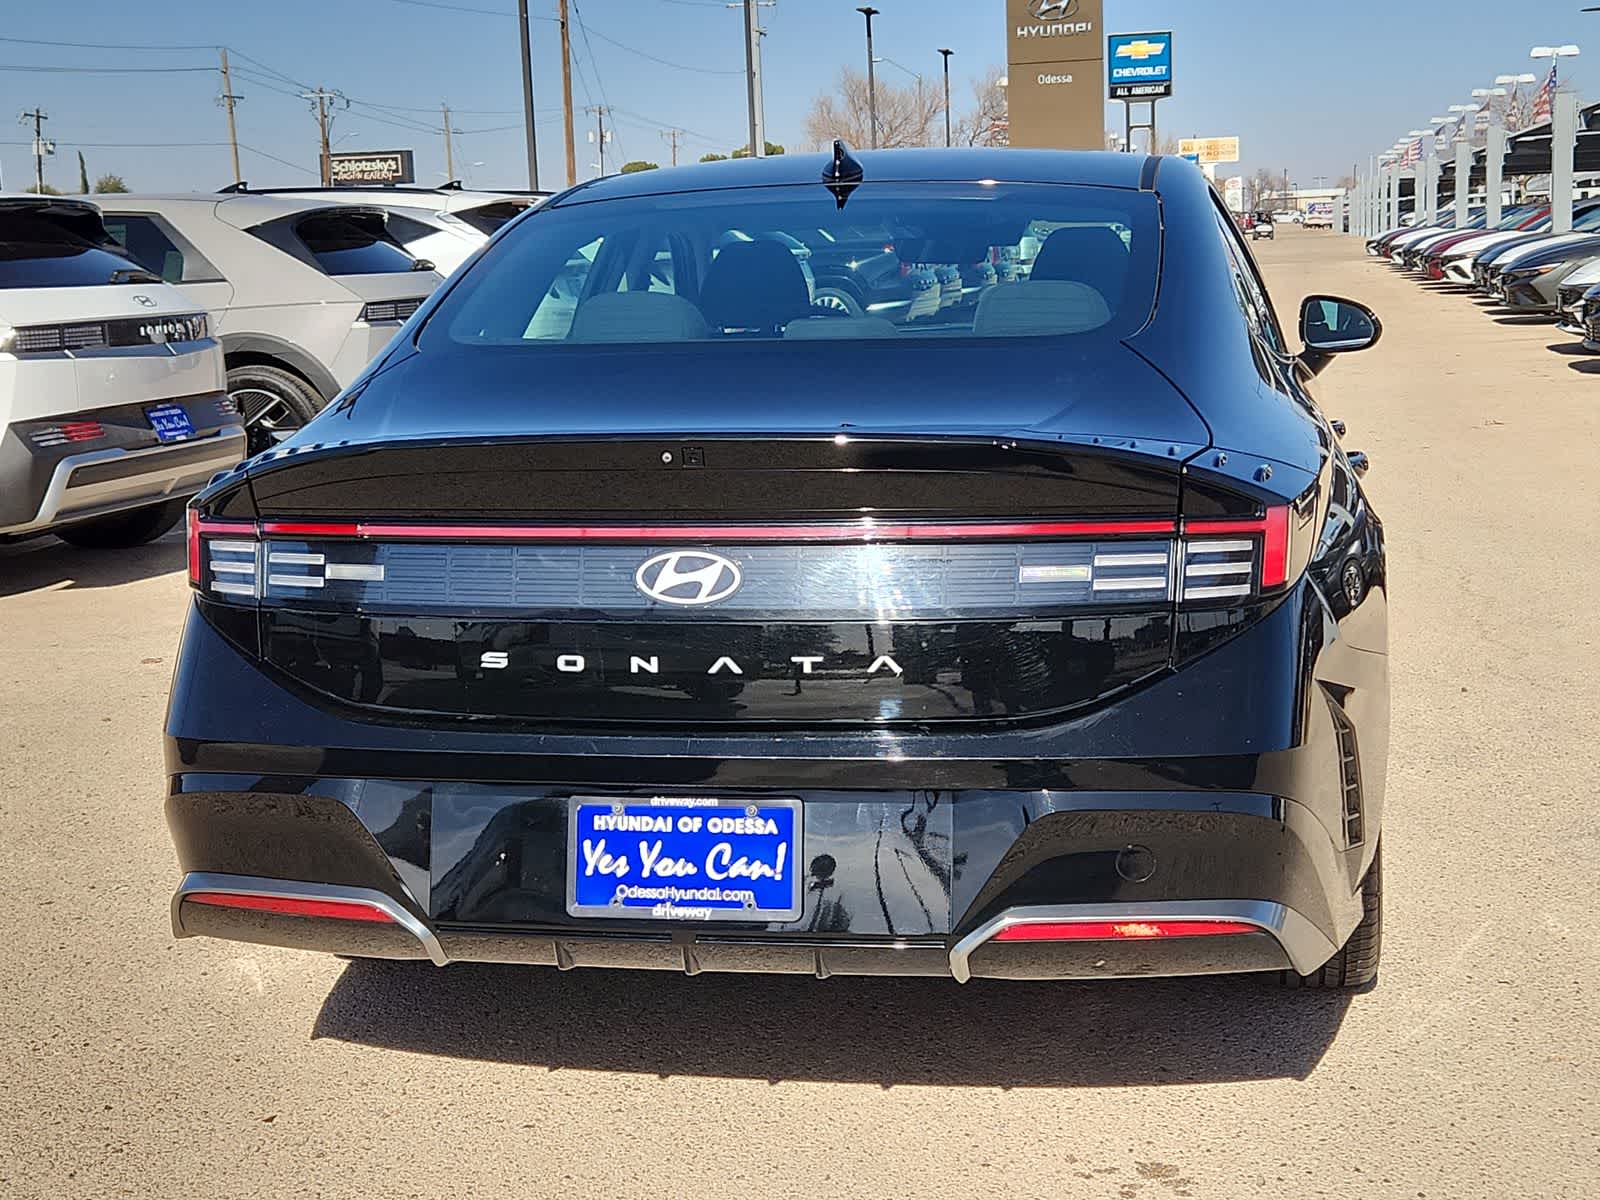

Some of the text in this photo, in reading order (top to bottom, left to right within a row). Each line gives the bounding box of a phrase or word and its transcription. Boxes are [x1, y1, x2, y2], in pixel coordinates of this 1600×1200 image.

[1016, 22, 1092, 38] HYUNDAI
[1037, 74, 1073, 85] Odessa
[1113, 65, 1168, 78] CHEVROLET
[1116, 85, 1165, 96] ALL AMERICAN
[332, 159, 397, 172] Schlotzsky's
[480, 652, 903, 676] SONATA
[650, 797, 719, 808] driveway.com
[593, 815, 779, 835] HYUNDAI OF ODESSA
[582, 839, 788, 881] Yes You Can!
[616, 885, 755, 903] OdessaHyundai.com
[652, 902, 713, 921] driveway
